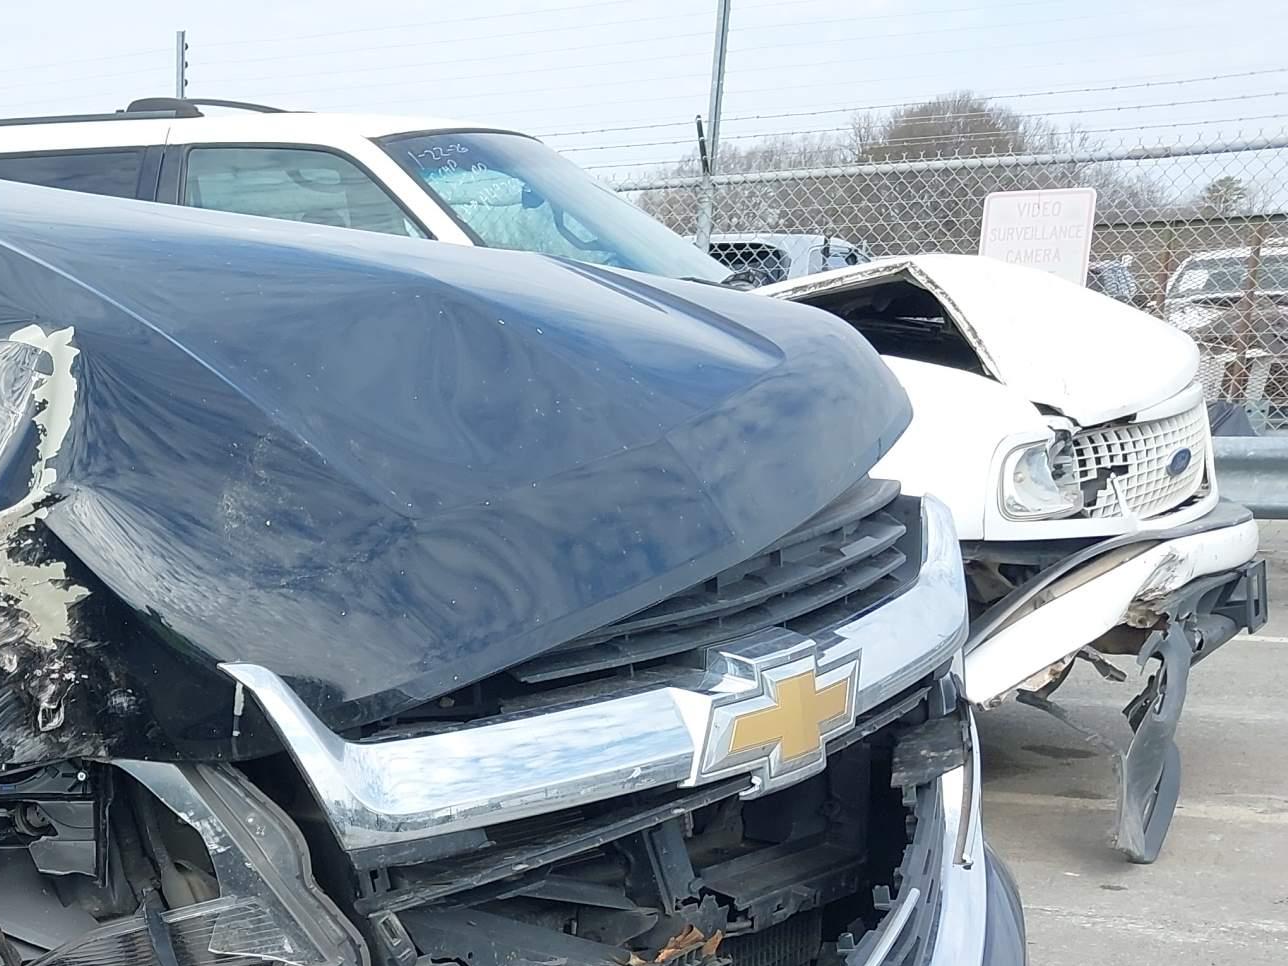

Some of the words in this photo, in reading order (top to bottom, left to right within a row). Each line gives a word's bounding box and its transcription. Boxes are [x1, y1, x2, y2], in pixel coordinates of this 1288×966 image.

[1017, 201, 1061, 217] VIDEO
[990, 225, 1084, 242] SURVEILLANCE
[1007, 248, 1060, 264] CAMERA
